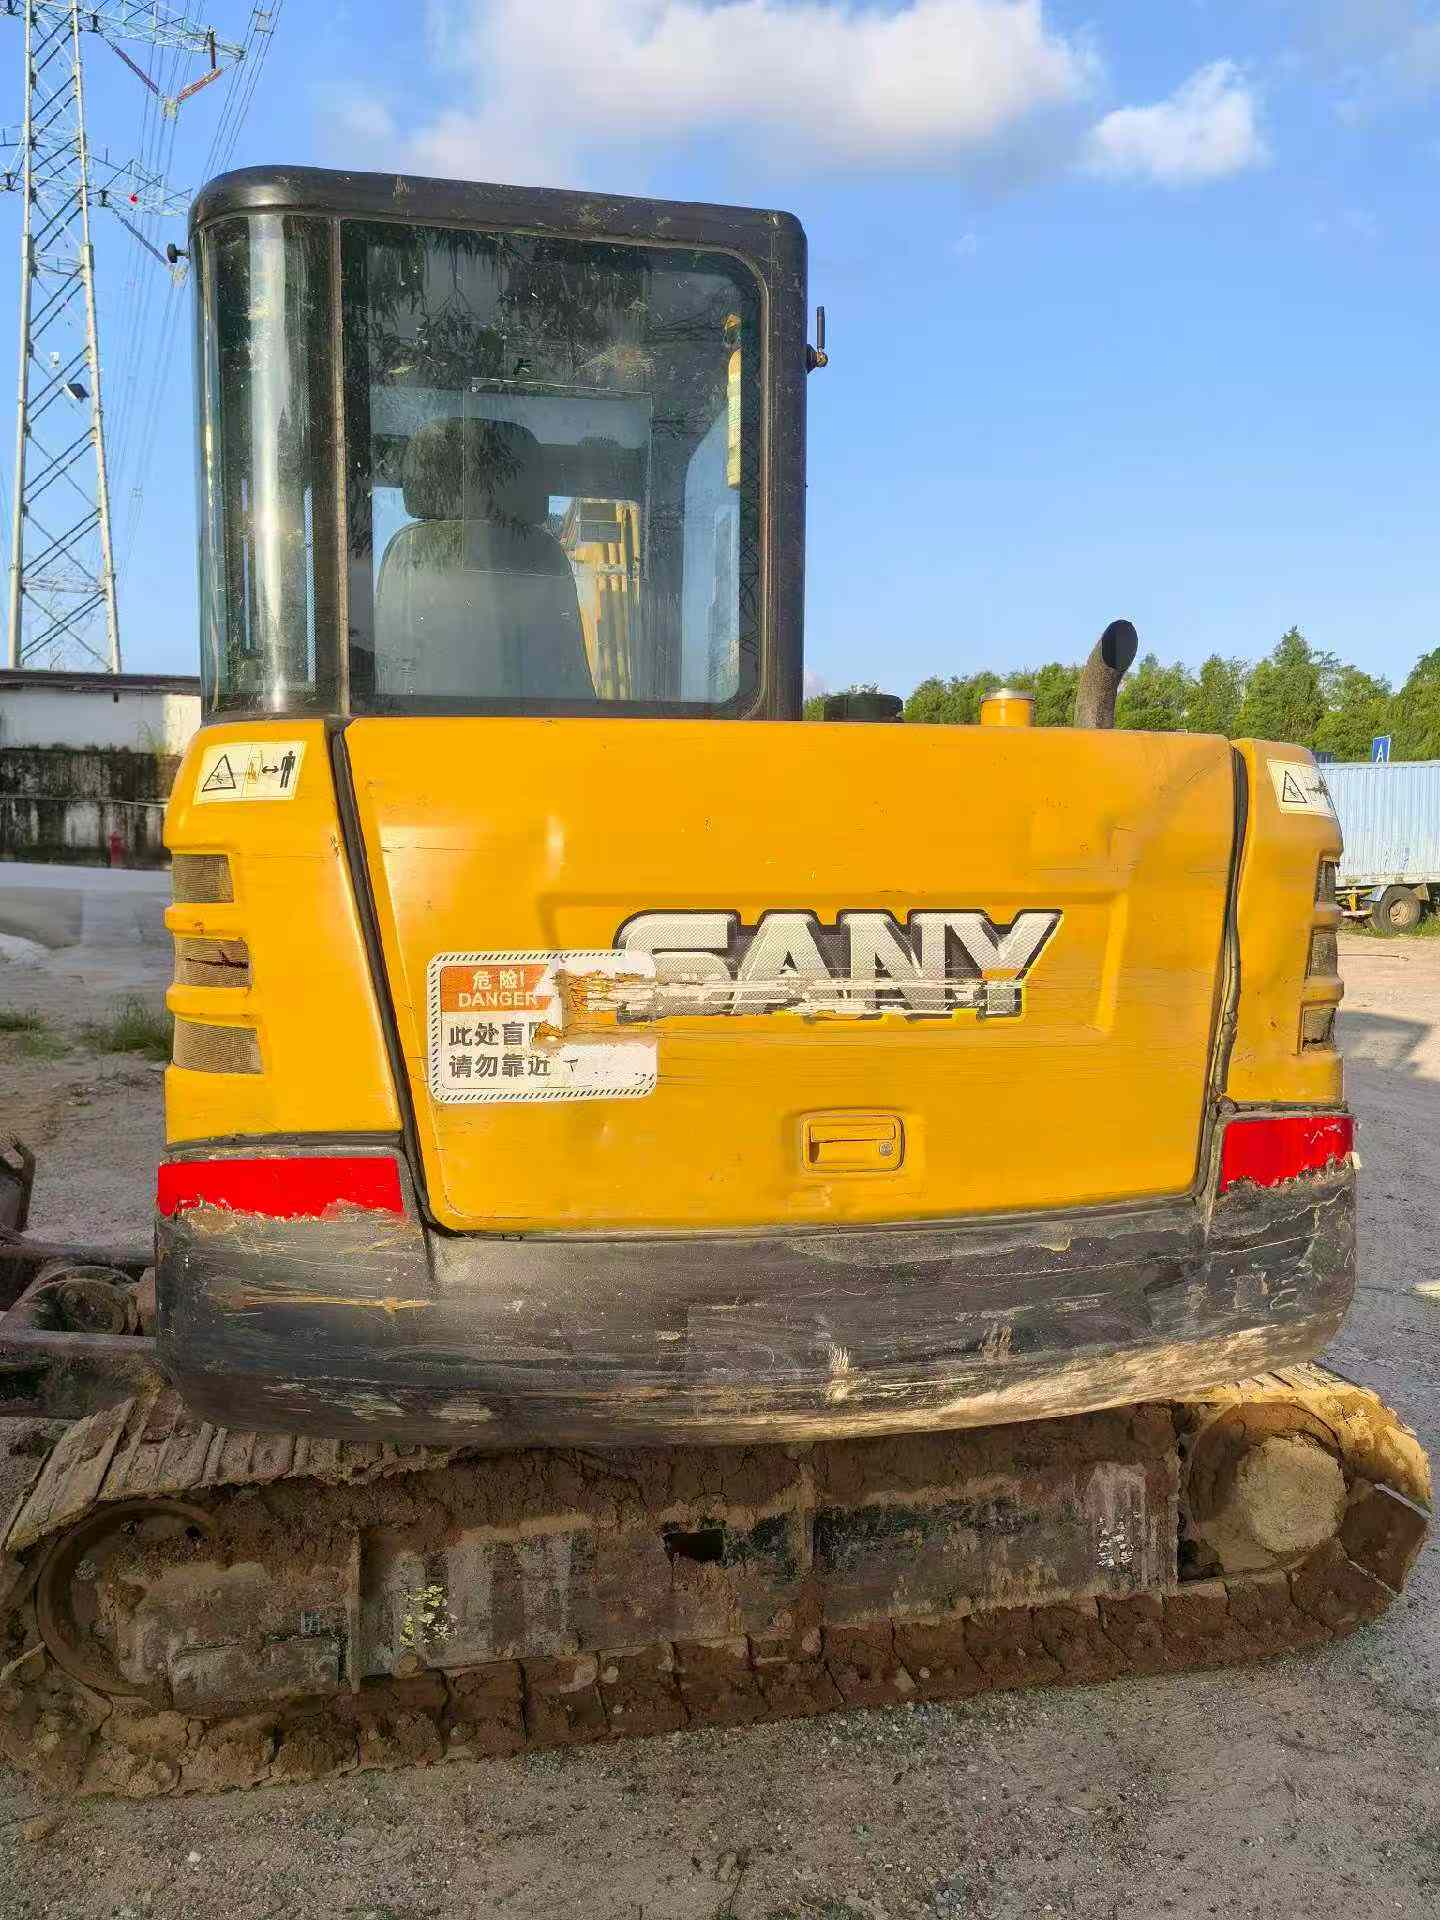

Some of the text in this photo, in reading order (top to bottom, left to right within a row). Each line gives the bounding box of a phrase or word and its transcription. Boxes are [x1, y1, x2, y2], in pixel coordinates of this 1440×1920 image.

[612, 909, 1064, 1022] SANY
[448, 1021, 541, 1047] 此处盲
[448, 1053, 551, 1078] 请勿靠近
